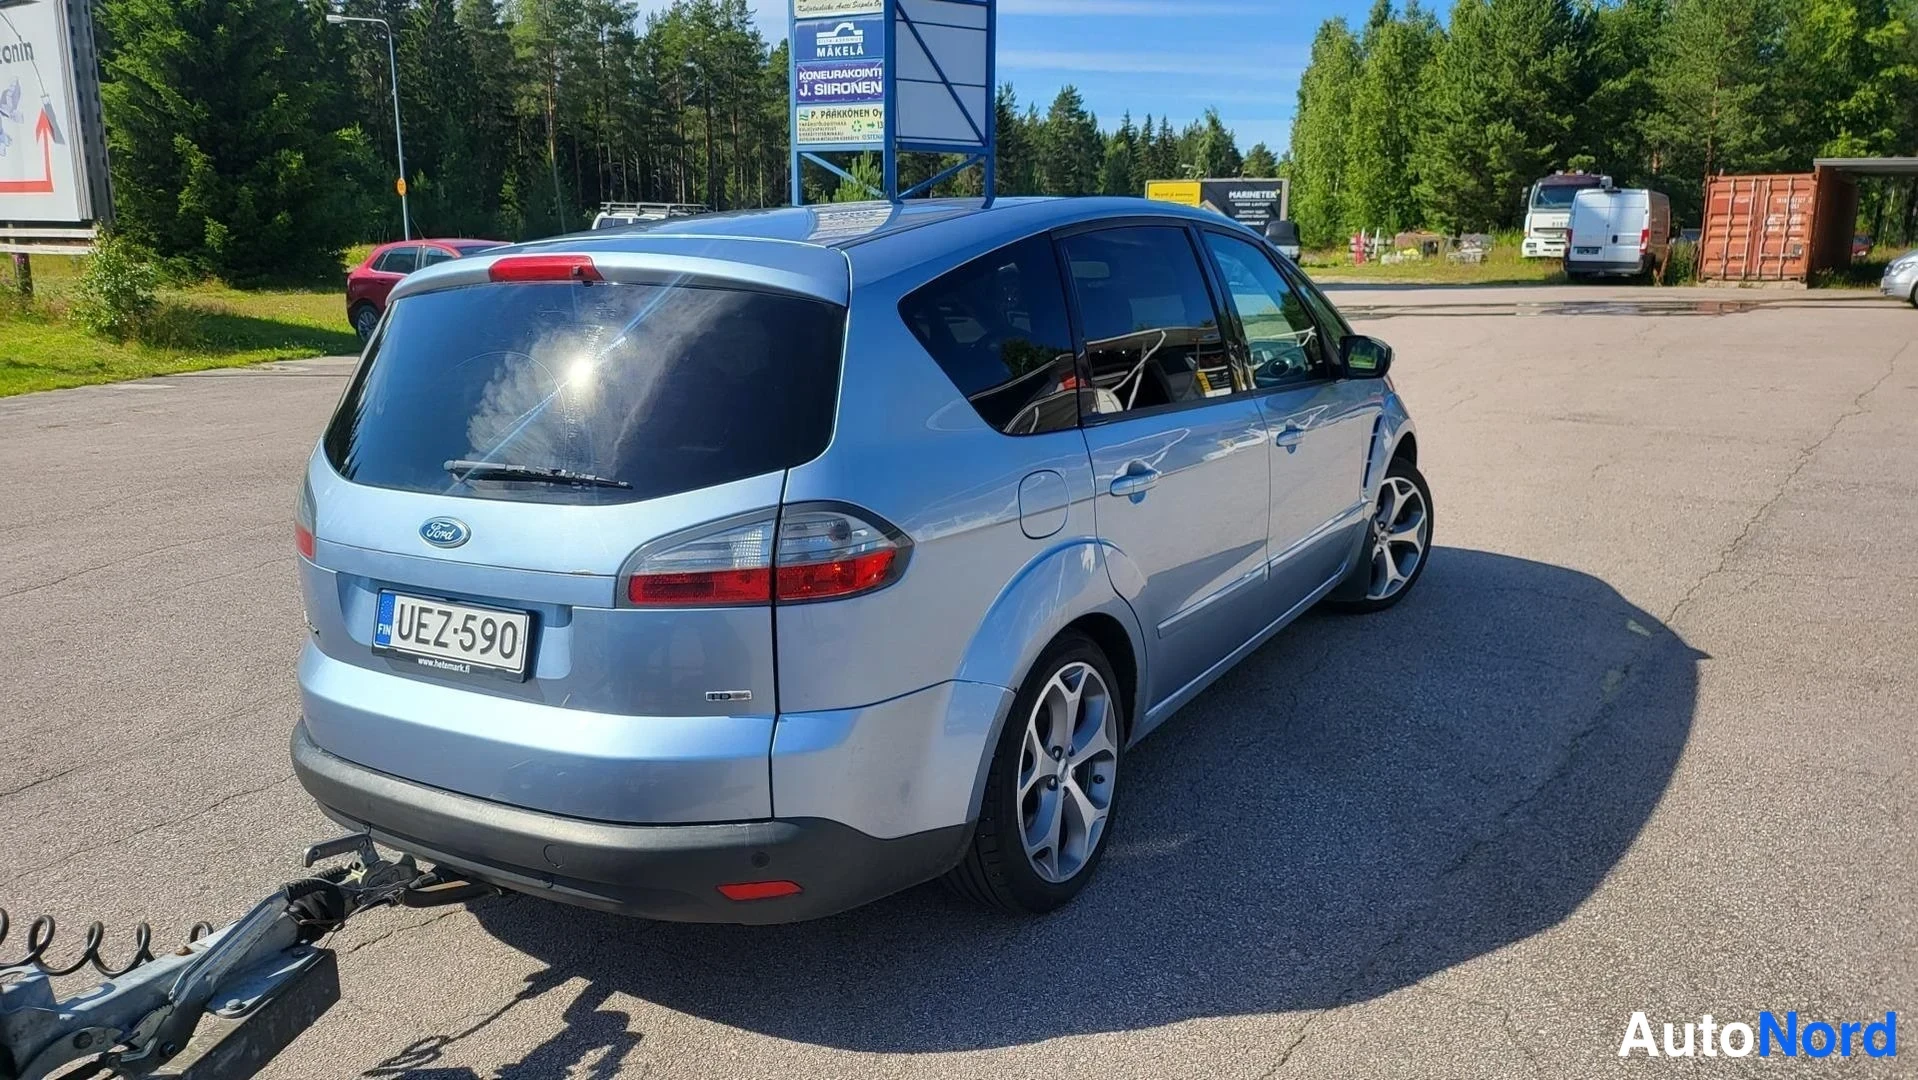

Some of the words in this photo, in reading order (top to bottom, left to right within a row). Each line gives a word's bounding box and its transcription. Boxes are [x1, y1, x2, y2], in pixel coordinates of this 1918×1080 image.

[0, 42, 34, 64] onin
[816, 43, 864, 57] MÄKELÄ
[799, 68, 882, 80] KONEURAKOINTI
[799, 83, 811, 97] J.
[814, 81, 883, 96] SIIRONEN
[820, 107, 870, 119] PÄÄKKÖNEN
[872, 108, 883, 119] Oy
[1228, 190, 1276, 199] MARINETEK
[426, 522, 456, 541] Ford
[377, 623, 391, 635] FIN
[397, 603, 518, 660] UEZ-590
